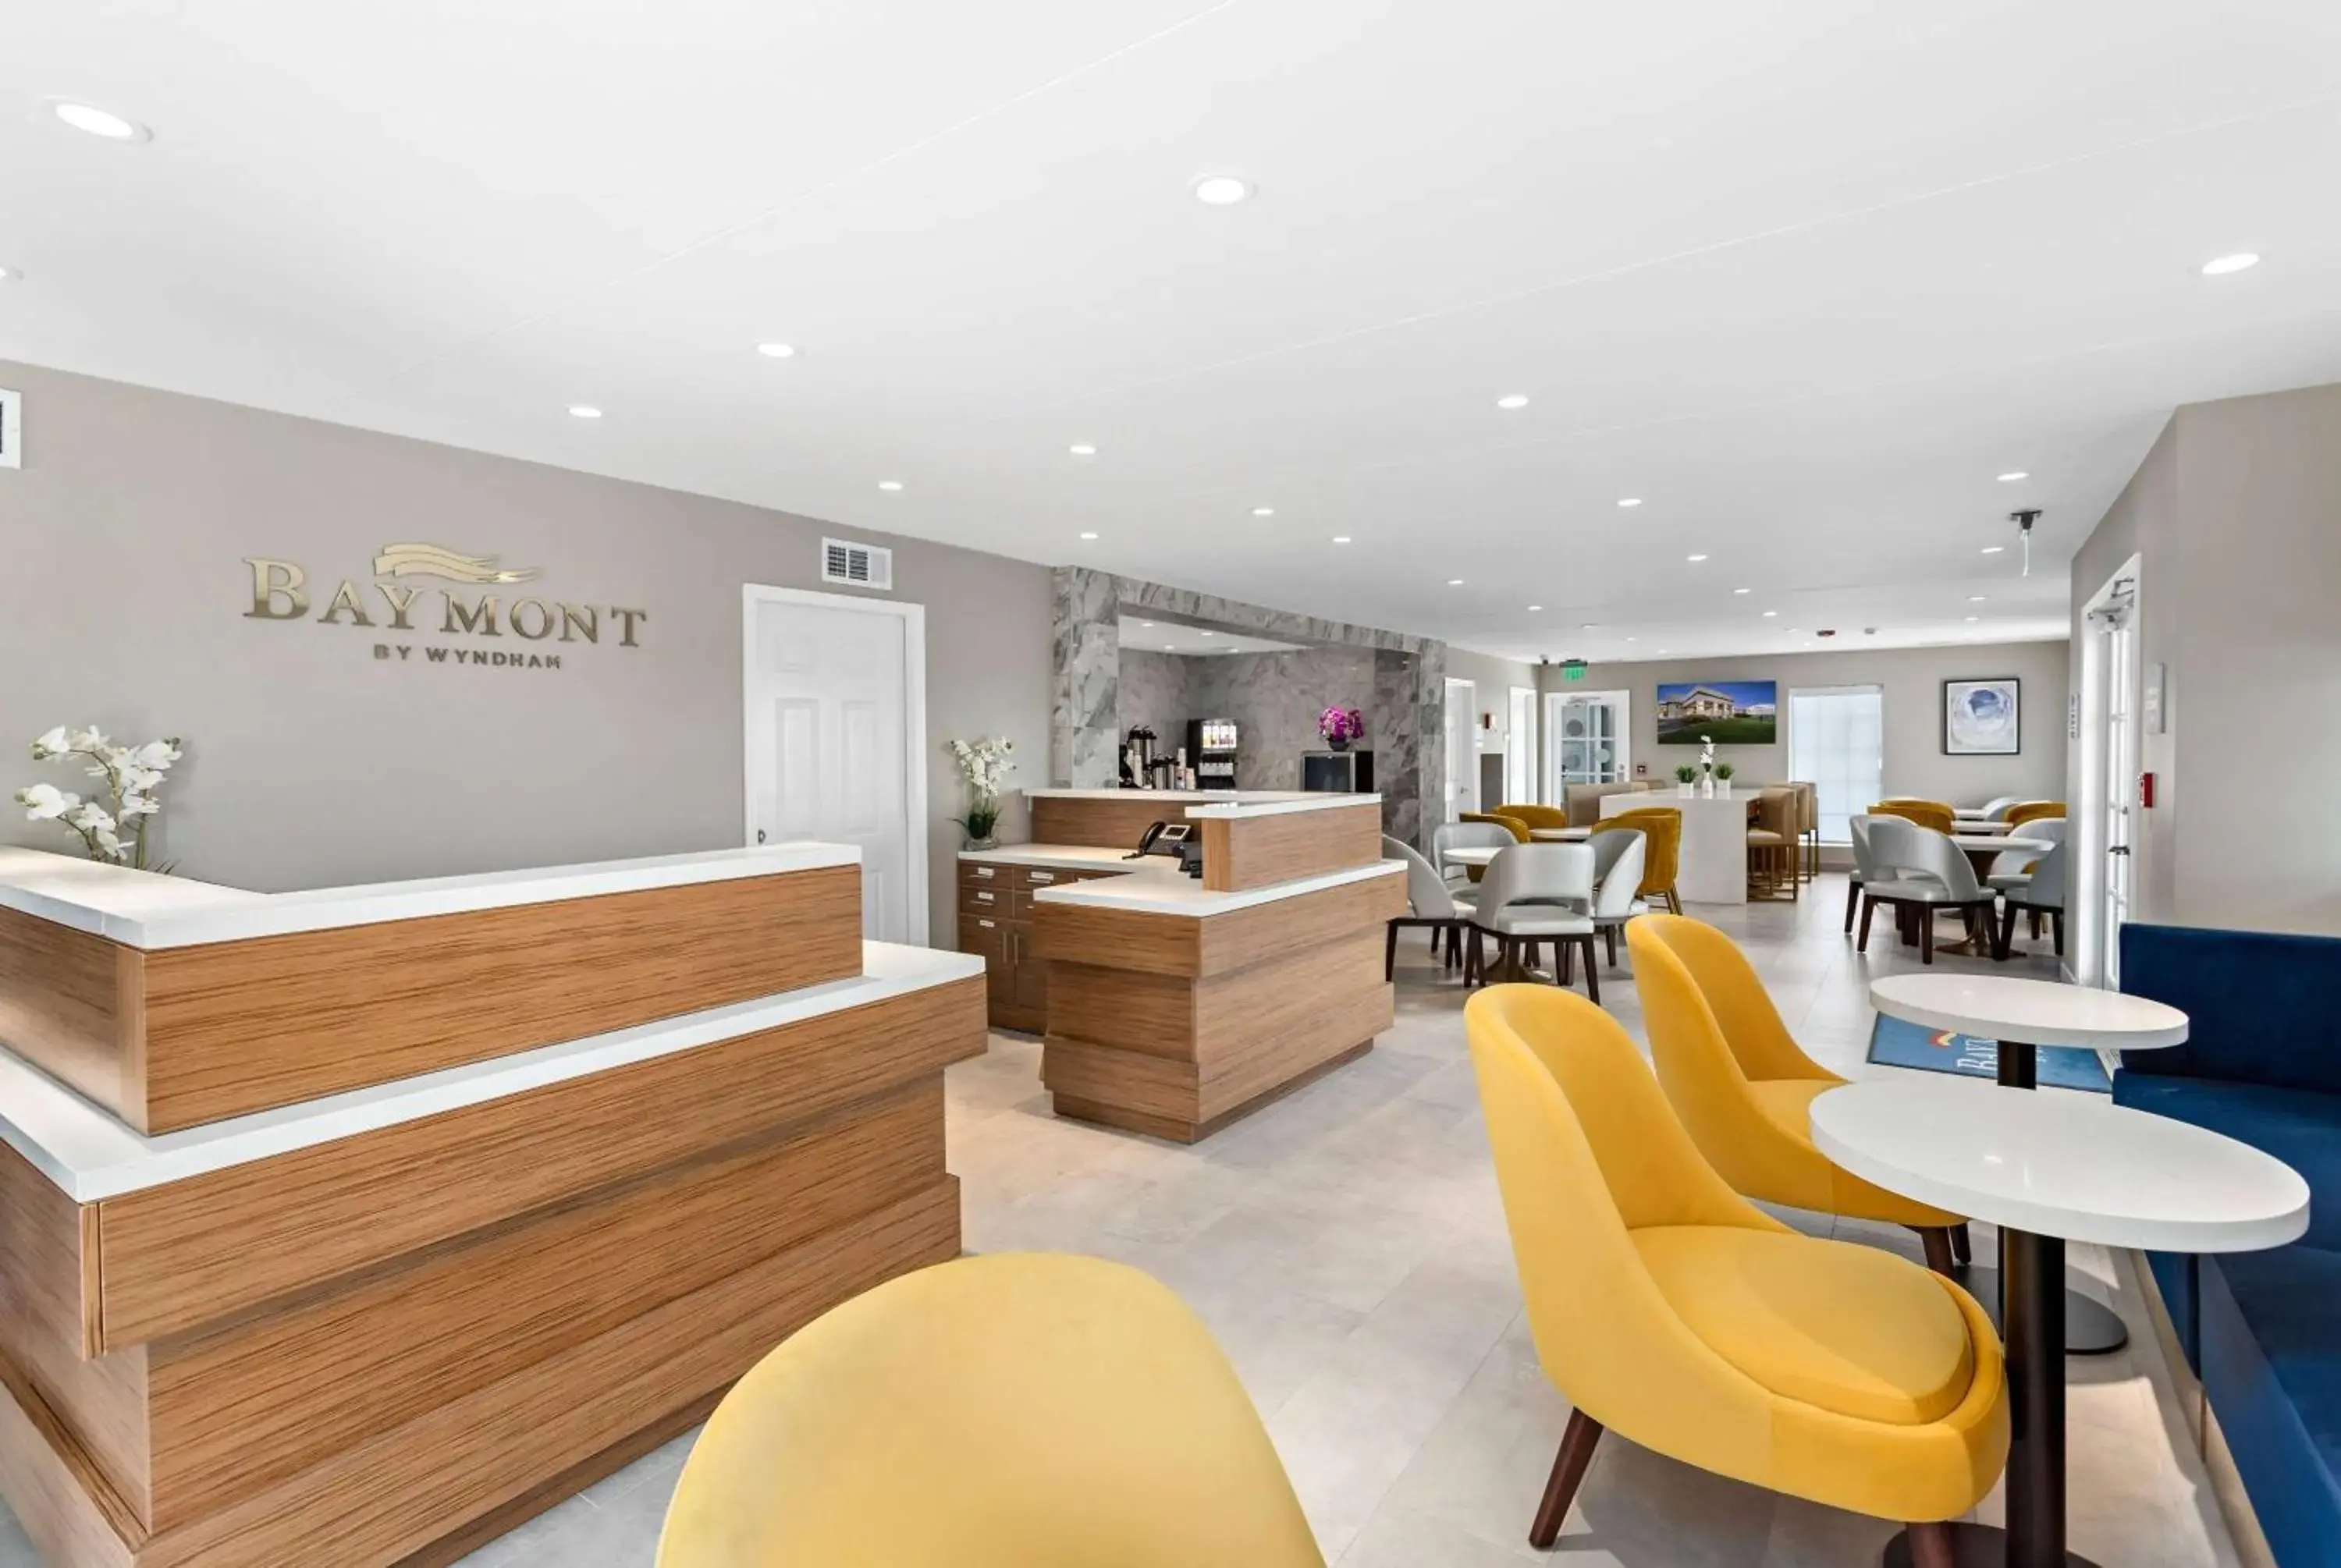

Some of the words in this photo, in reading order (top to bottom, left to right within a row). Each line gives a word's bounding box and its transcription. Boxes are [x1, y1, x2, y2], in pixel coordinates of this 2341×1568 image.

[242, 557, 647, 647] BAYMONT
[373, 644, 412, 661] BY
[425, 647, 562, 669] WYNDHAM
